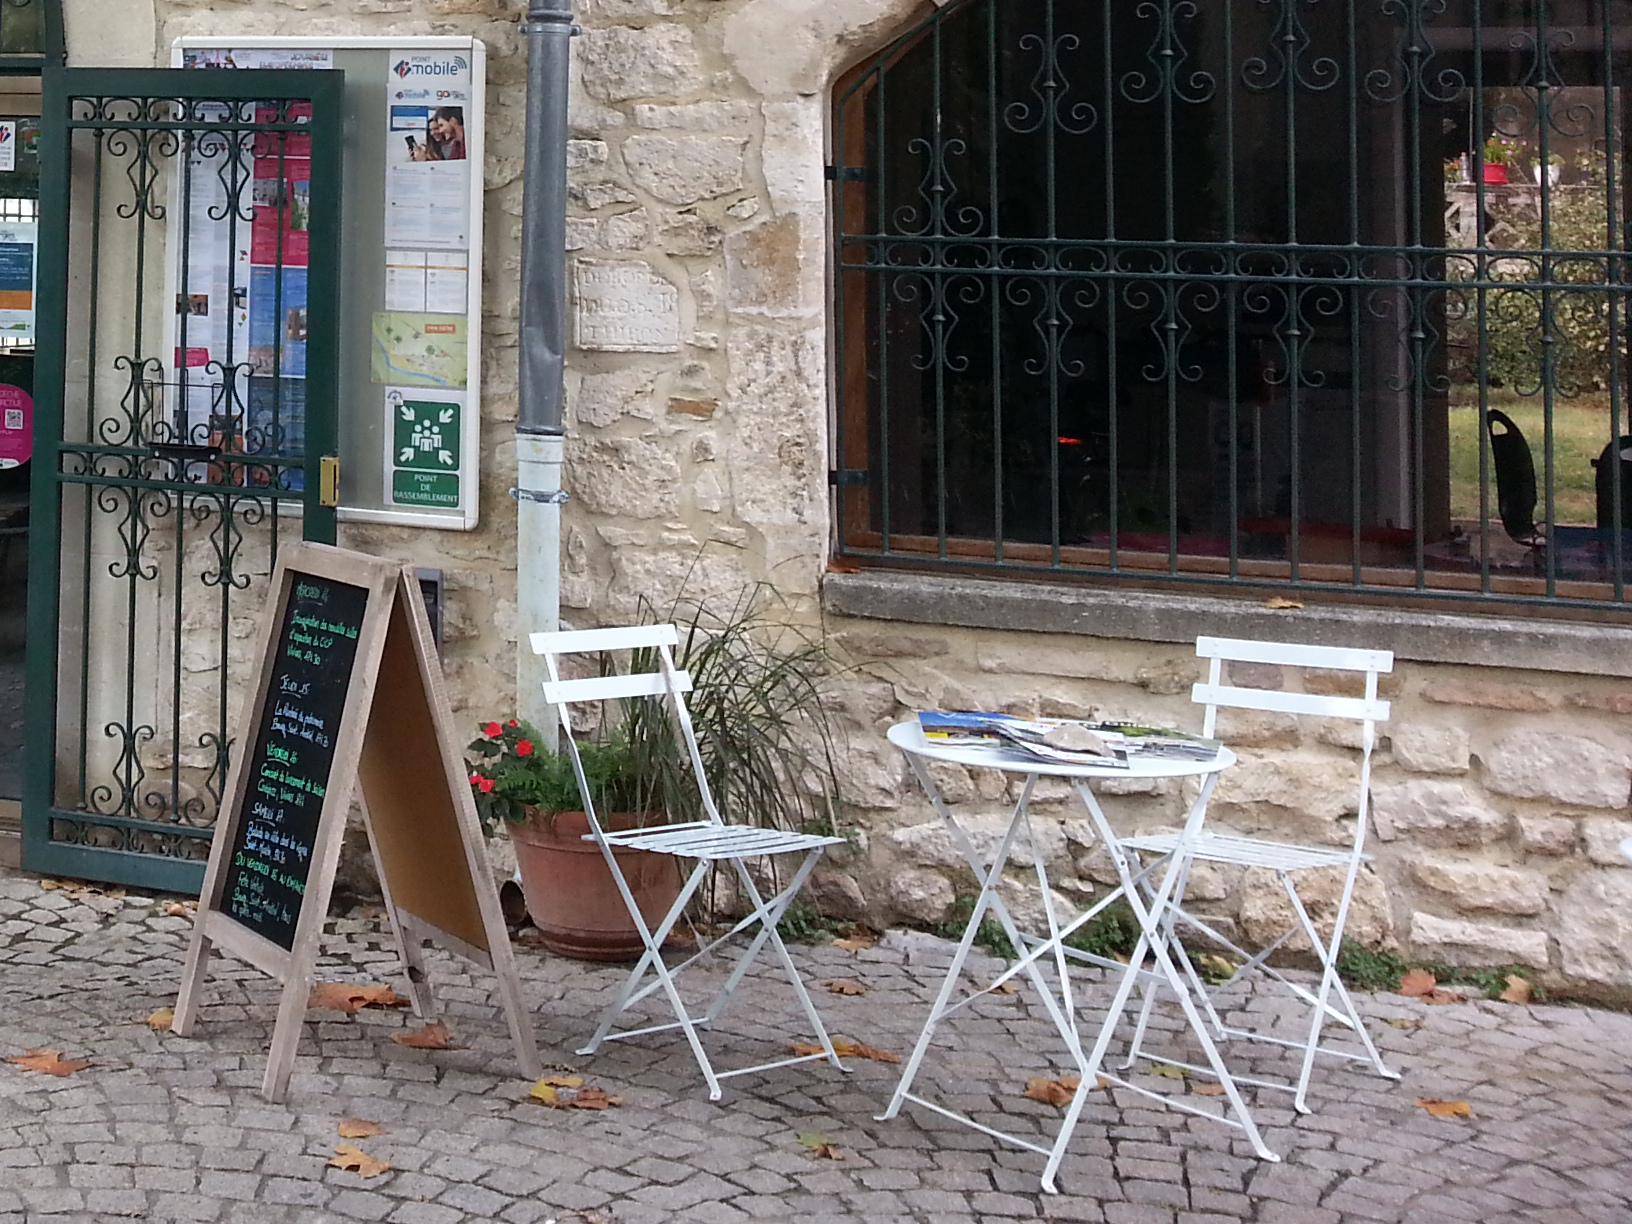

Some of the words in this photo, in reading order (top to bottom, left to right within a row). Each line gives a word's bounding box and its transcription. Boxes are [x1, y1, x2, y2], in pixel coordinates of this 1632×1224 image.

[414, 474, 438, 483] POINT
[420, 483, 430, 491] DE
[394, 490, 458, 502] RASSEMBLEMENT
